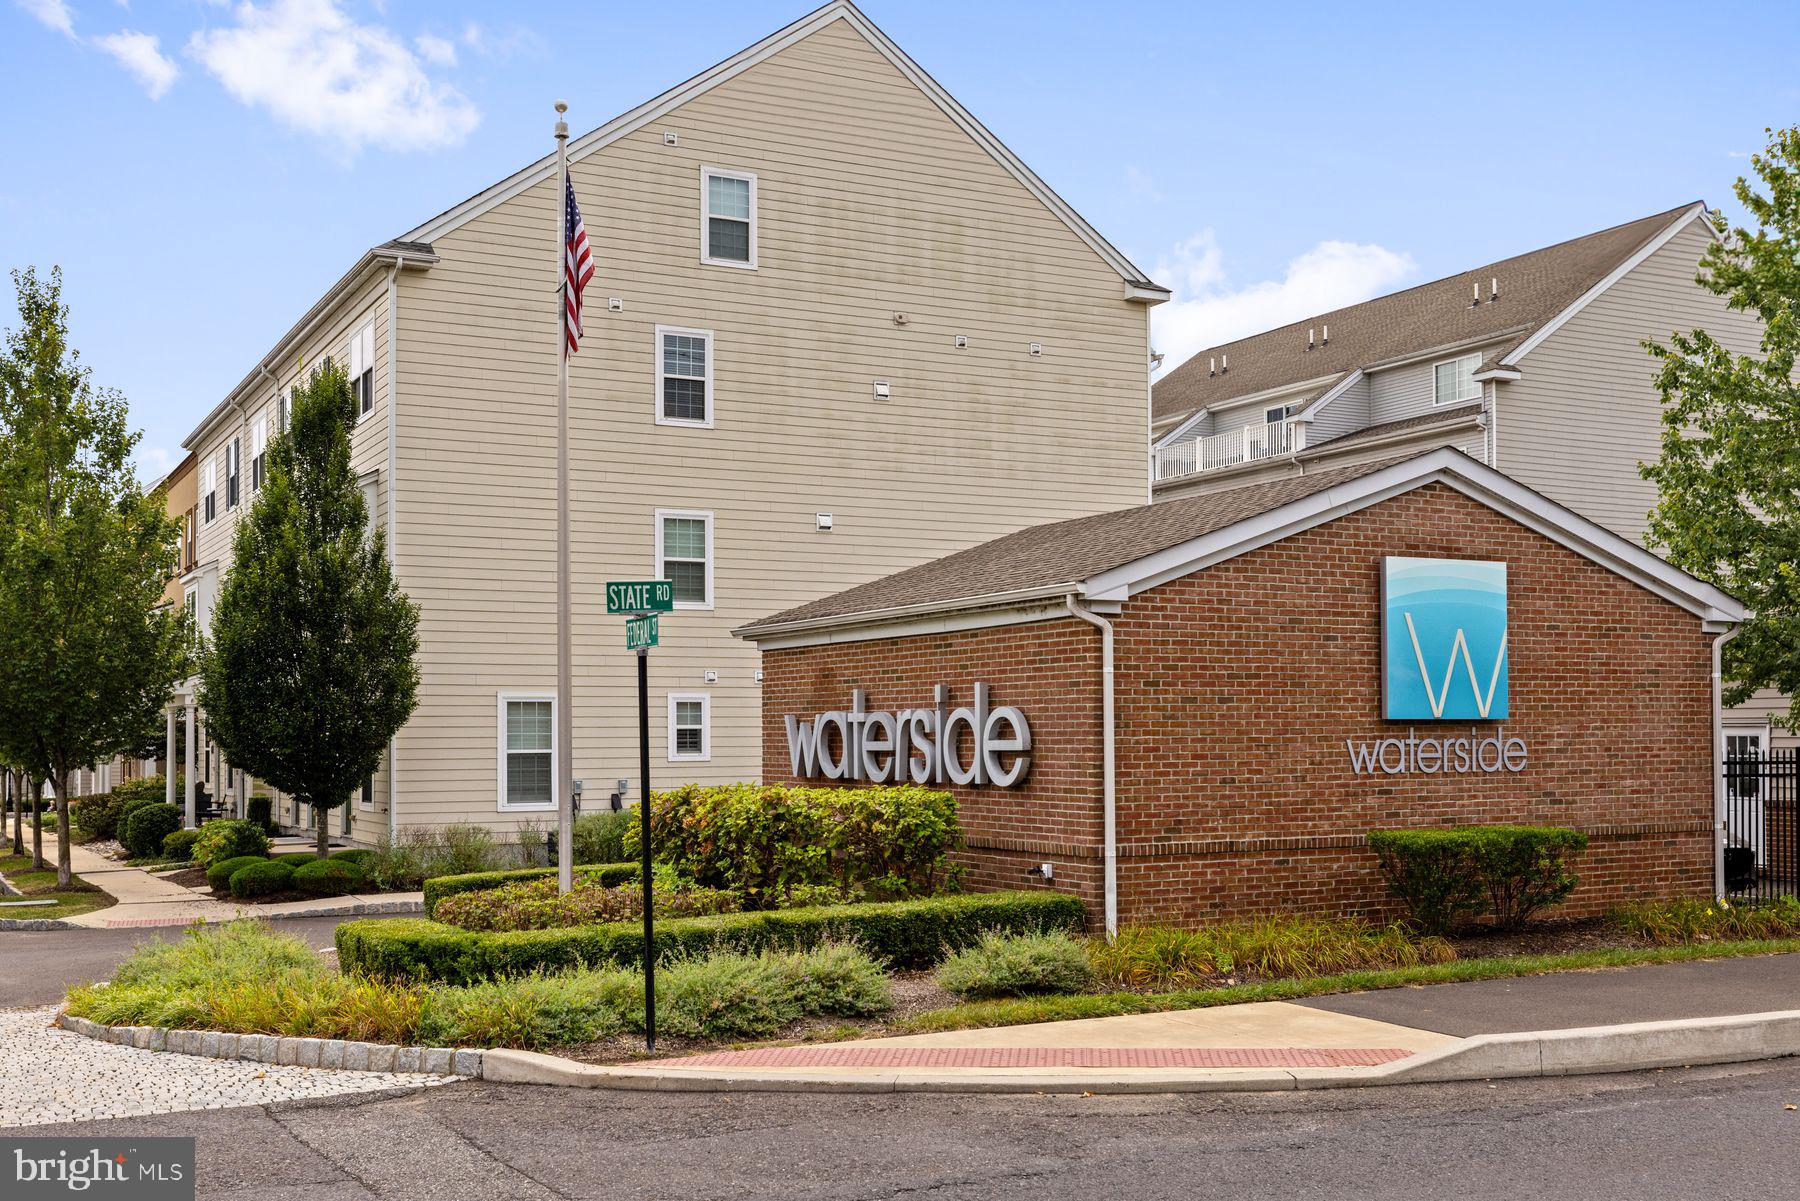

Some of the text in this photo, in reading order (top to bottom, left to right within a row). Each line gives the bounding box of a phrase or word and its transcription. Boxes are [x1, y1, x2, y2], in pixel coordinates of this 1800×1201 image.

[609, 584, 670, 610] STATE RD
[627, 619, 651, 647] FEDERAL
[784, 682, 1031, 787] waterside
[1346, 727, 1528, 774] waterside
